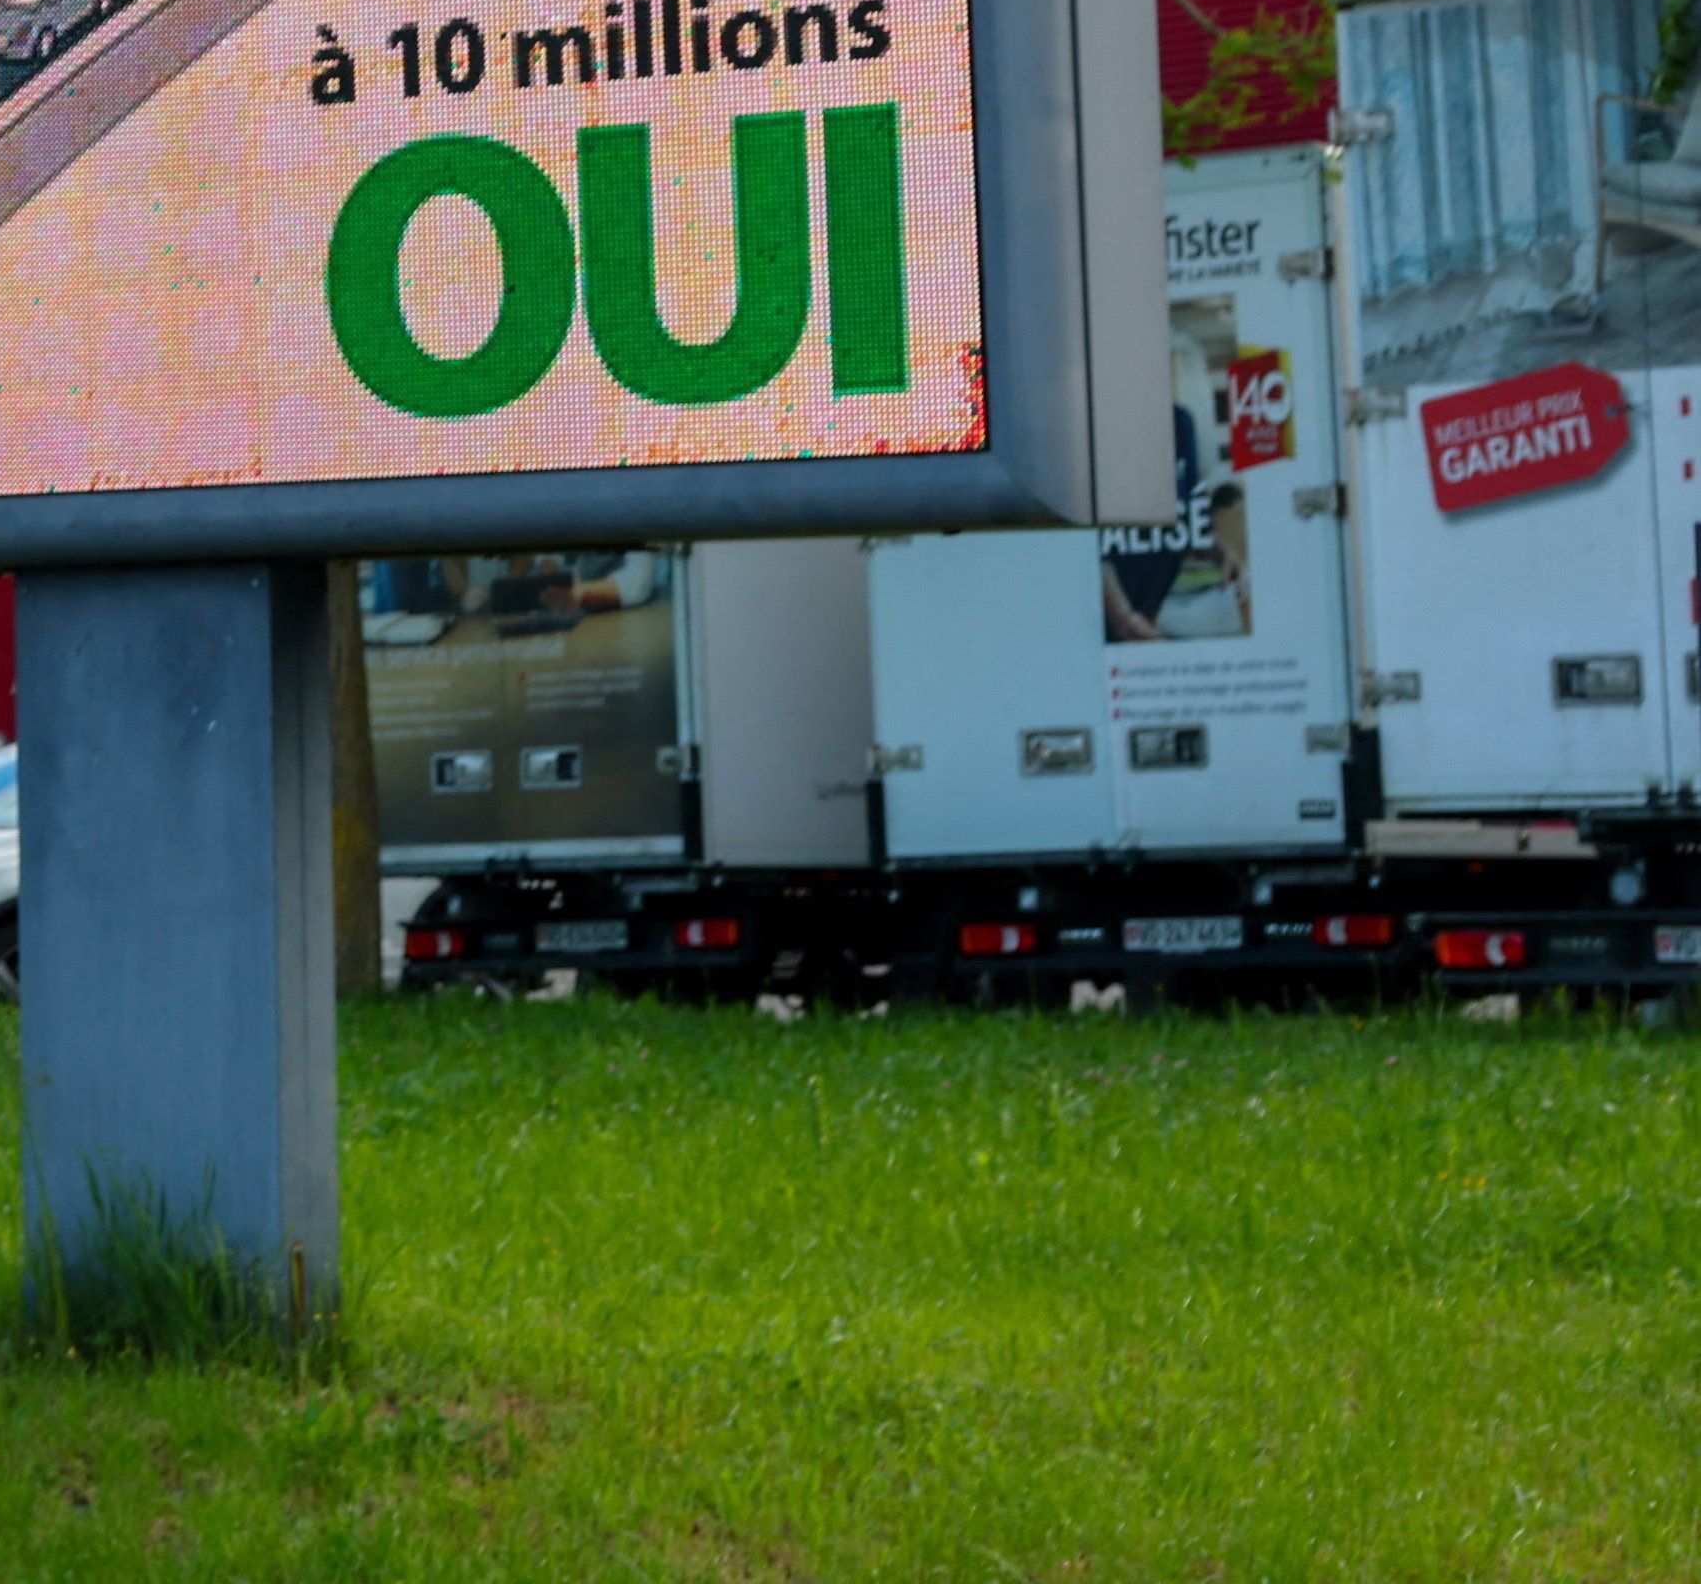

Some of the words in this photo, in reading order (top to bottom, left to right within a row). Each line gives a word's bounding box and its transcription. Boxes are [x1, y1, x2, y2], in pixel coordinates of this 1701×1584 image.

[310, 25, 356, 105] à
[389, 17, 486, 98] 10
[325, 99, 909, 422] OUI
[1228, 370, 1293, 426] 140
[1433, 401, 1535, 446] MEILLEUR
[1536, 388, 1584, 420] PRIX
[1439, 414, 1592, 484] GARANTI
